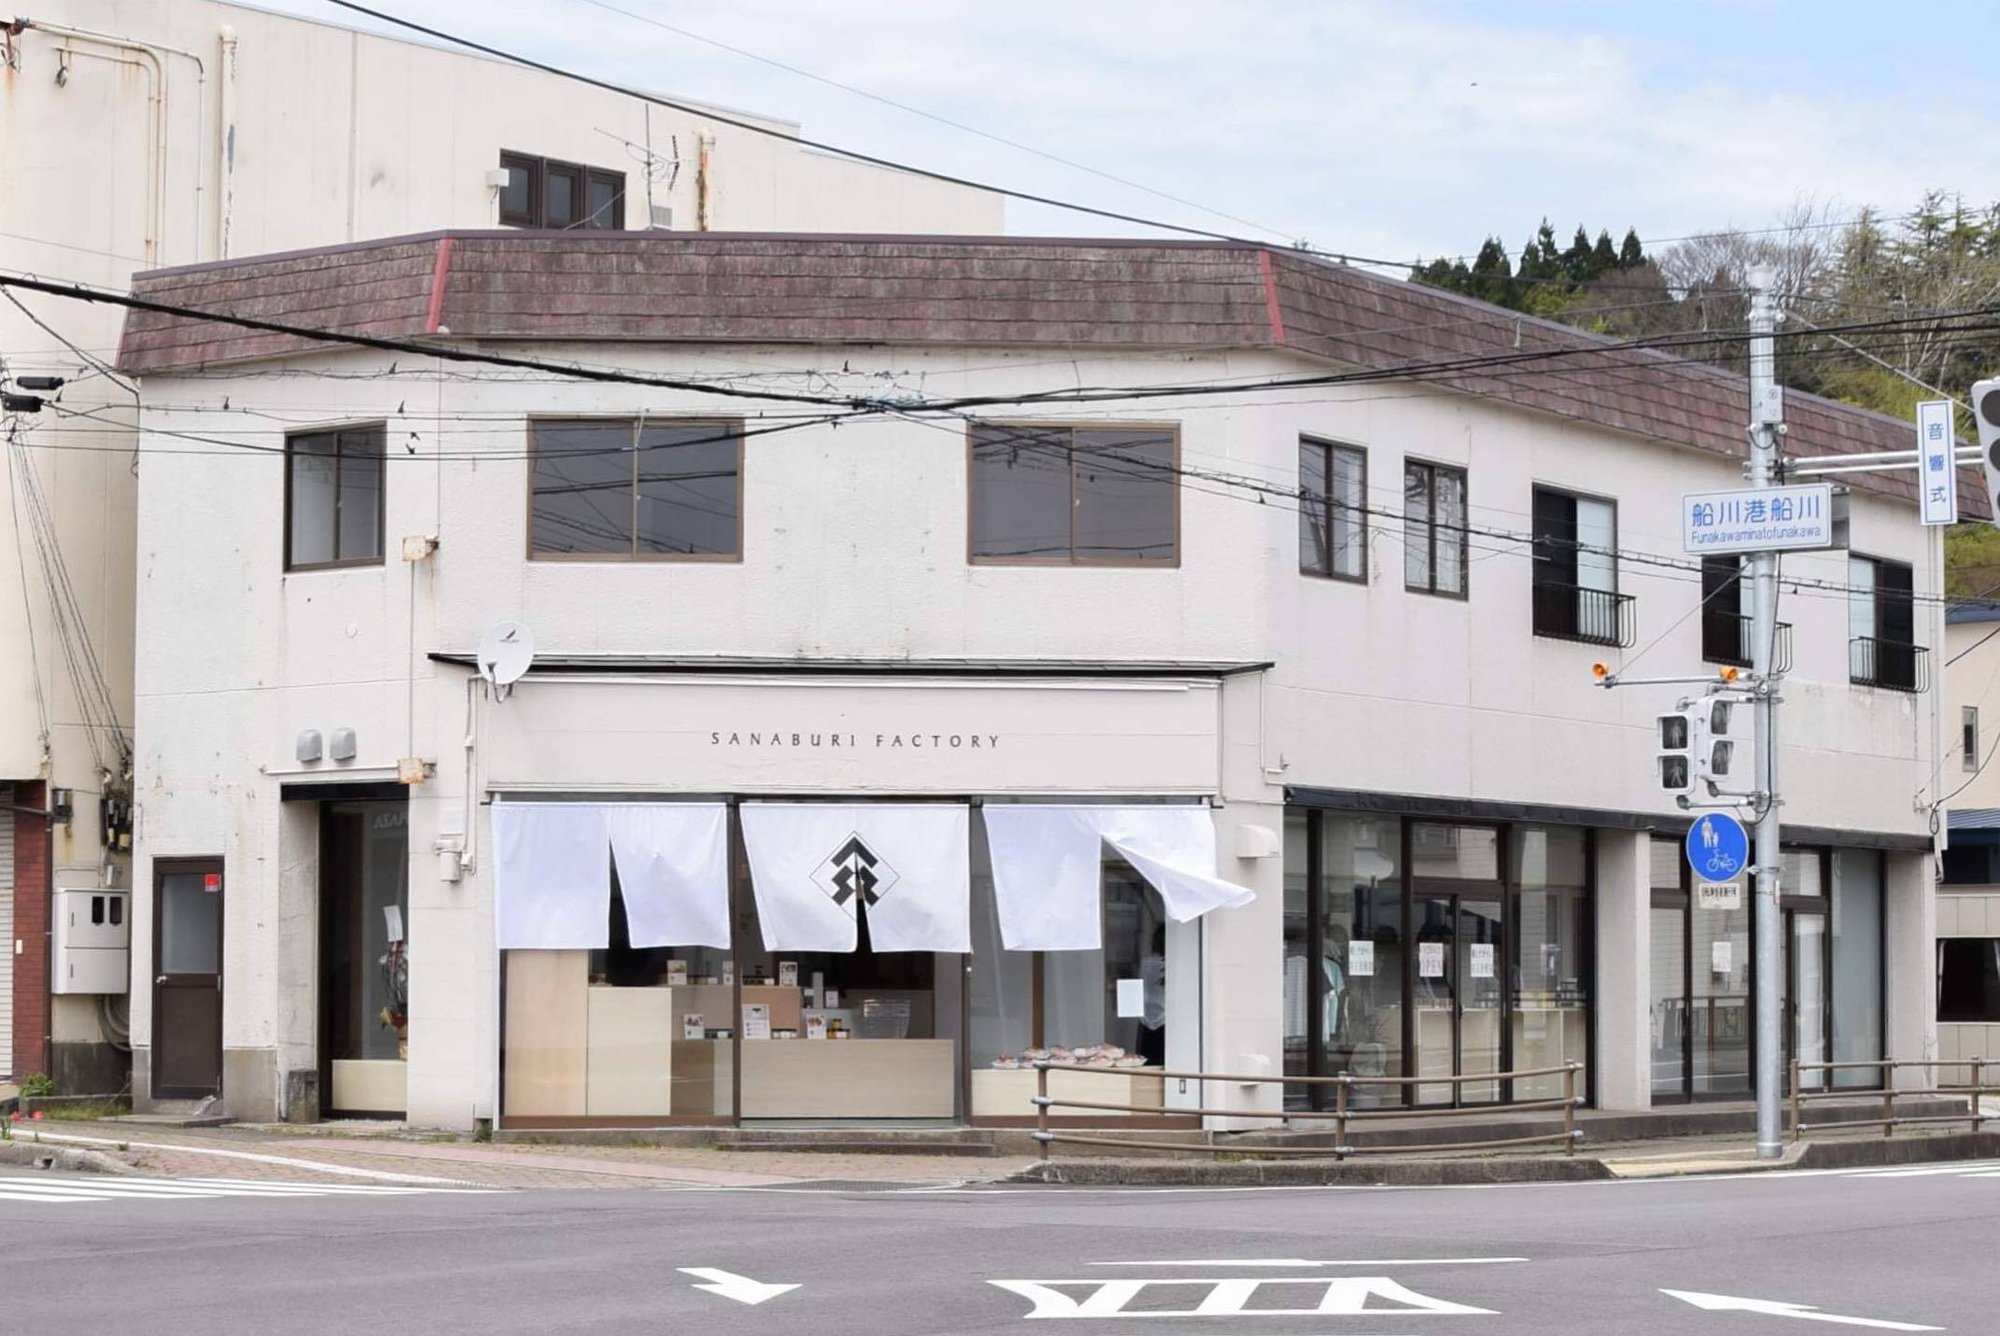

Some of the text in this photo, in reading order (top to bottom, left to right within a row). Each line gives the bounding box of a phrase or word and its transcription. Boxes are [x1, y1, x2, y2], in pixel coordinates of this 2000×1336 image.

[1927, 422, 1947, 504] 音響式
[1692, 495, 1820, 528] 船川港船川
[1691, 526, 1821, 545] Funakawaminatofunakawa
[711, 732, 1000, 748] SANABURI FACTORY
